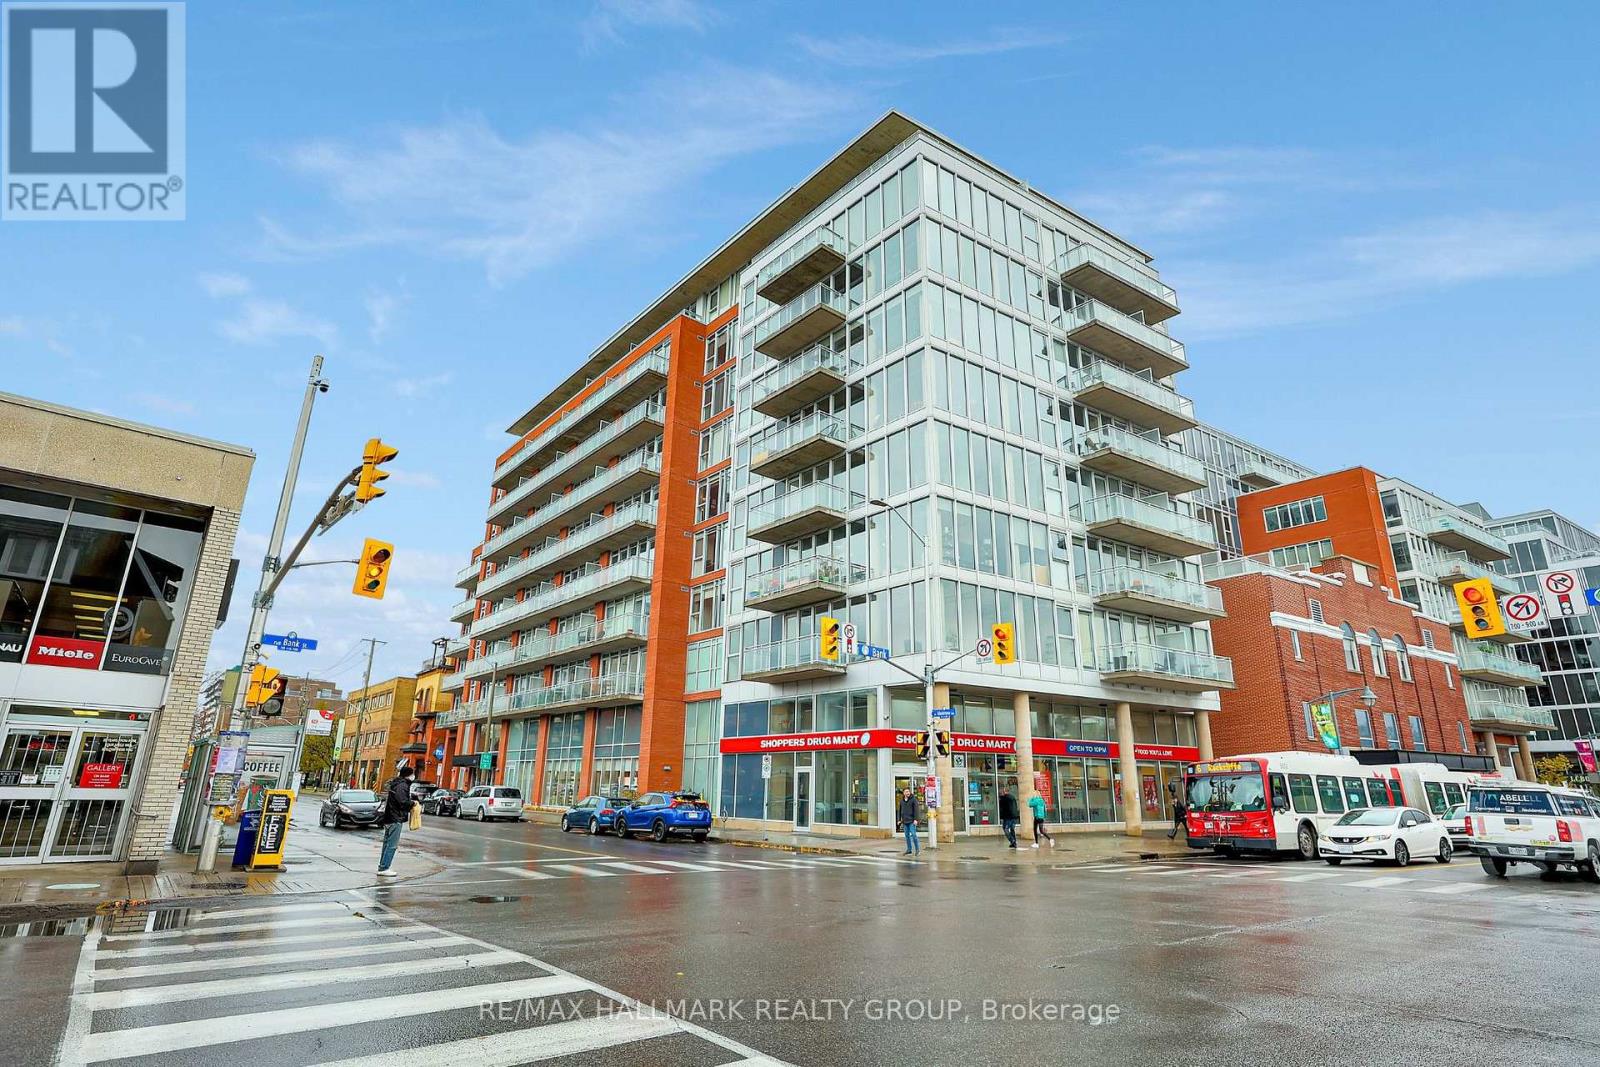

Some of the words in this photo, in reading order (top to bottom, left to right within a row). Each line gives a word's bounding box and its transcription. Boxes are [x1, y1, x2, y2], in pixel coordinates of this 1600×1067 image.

[283, 638, 300, 648] Bank
[37, 645, 95, 660] Miele
[872, 647, 888, 660] Bank
[760, 738, 805, 748] SHOPPERS
[807, 736, 831, 747] DRUG
[833, 735, 860, 745] MART
[957, 738, 985, 748] DRUG
[986, 740, 1013, 749] MART
[1069, 744, 1085, 752] OPEN
[86, 764, 121, 772] GALLERY
[243, 761, 281, 773] COFFEE
[265, 815, 280, 849] FREE
